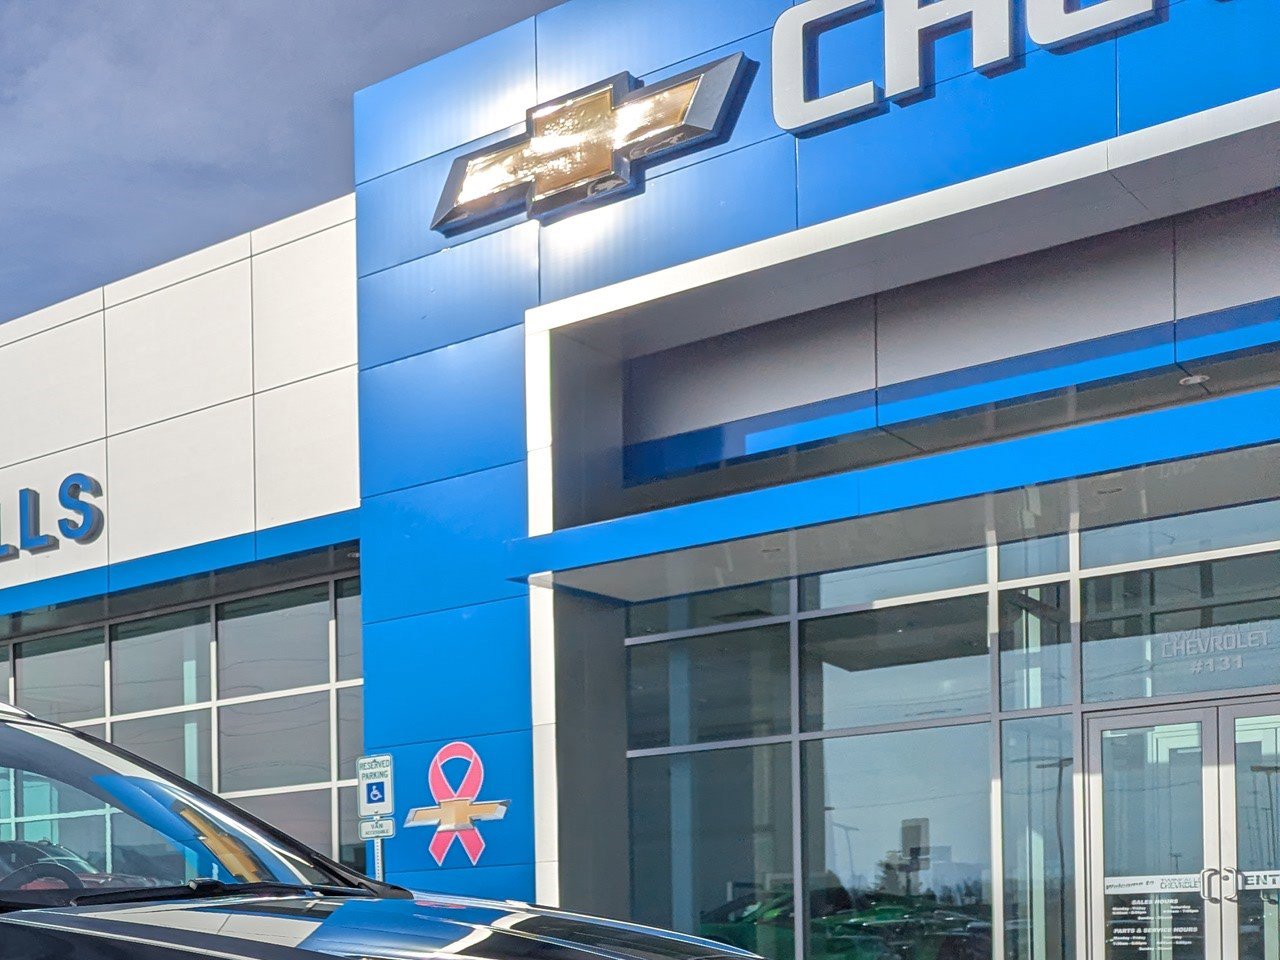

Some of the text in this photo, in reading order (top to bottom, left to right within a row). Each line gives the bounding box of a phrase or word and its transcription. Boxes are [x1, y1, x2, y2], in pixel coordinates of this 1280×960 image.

[1162, 630, 1270, 658] CHEVROLET
[360, 759, 390, 770] RESERVED
[362, 770, 389, 780] PARKING
[371, 822, 383, 830] VAN
[1245, 874, 1280, 886] ENT
